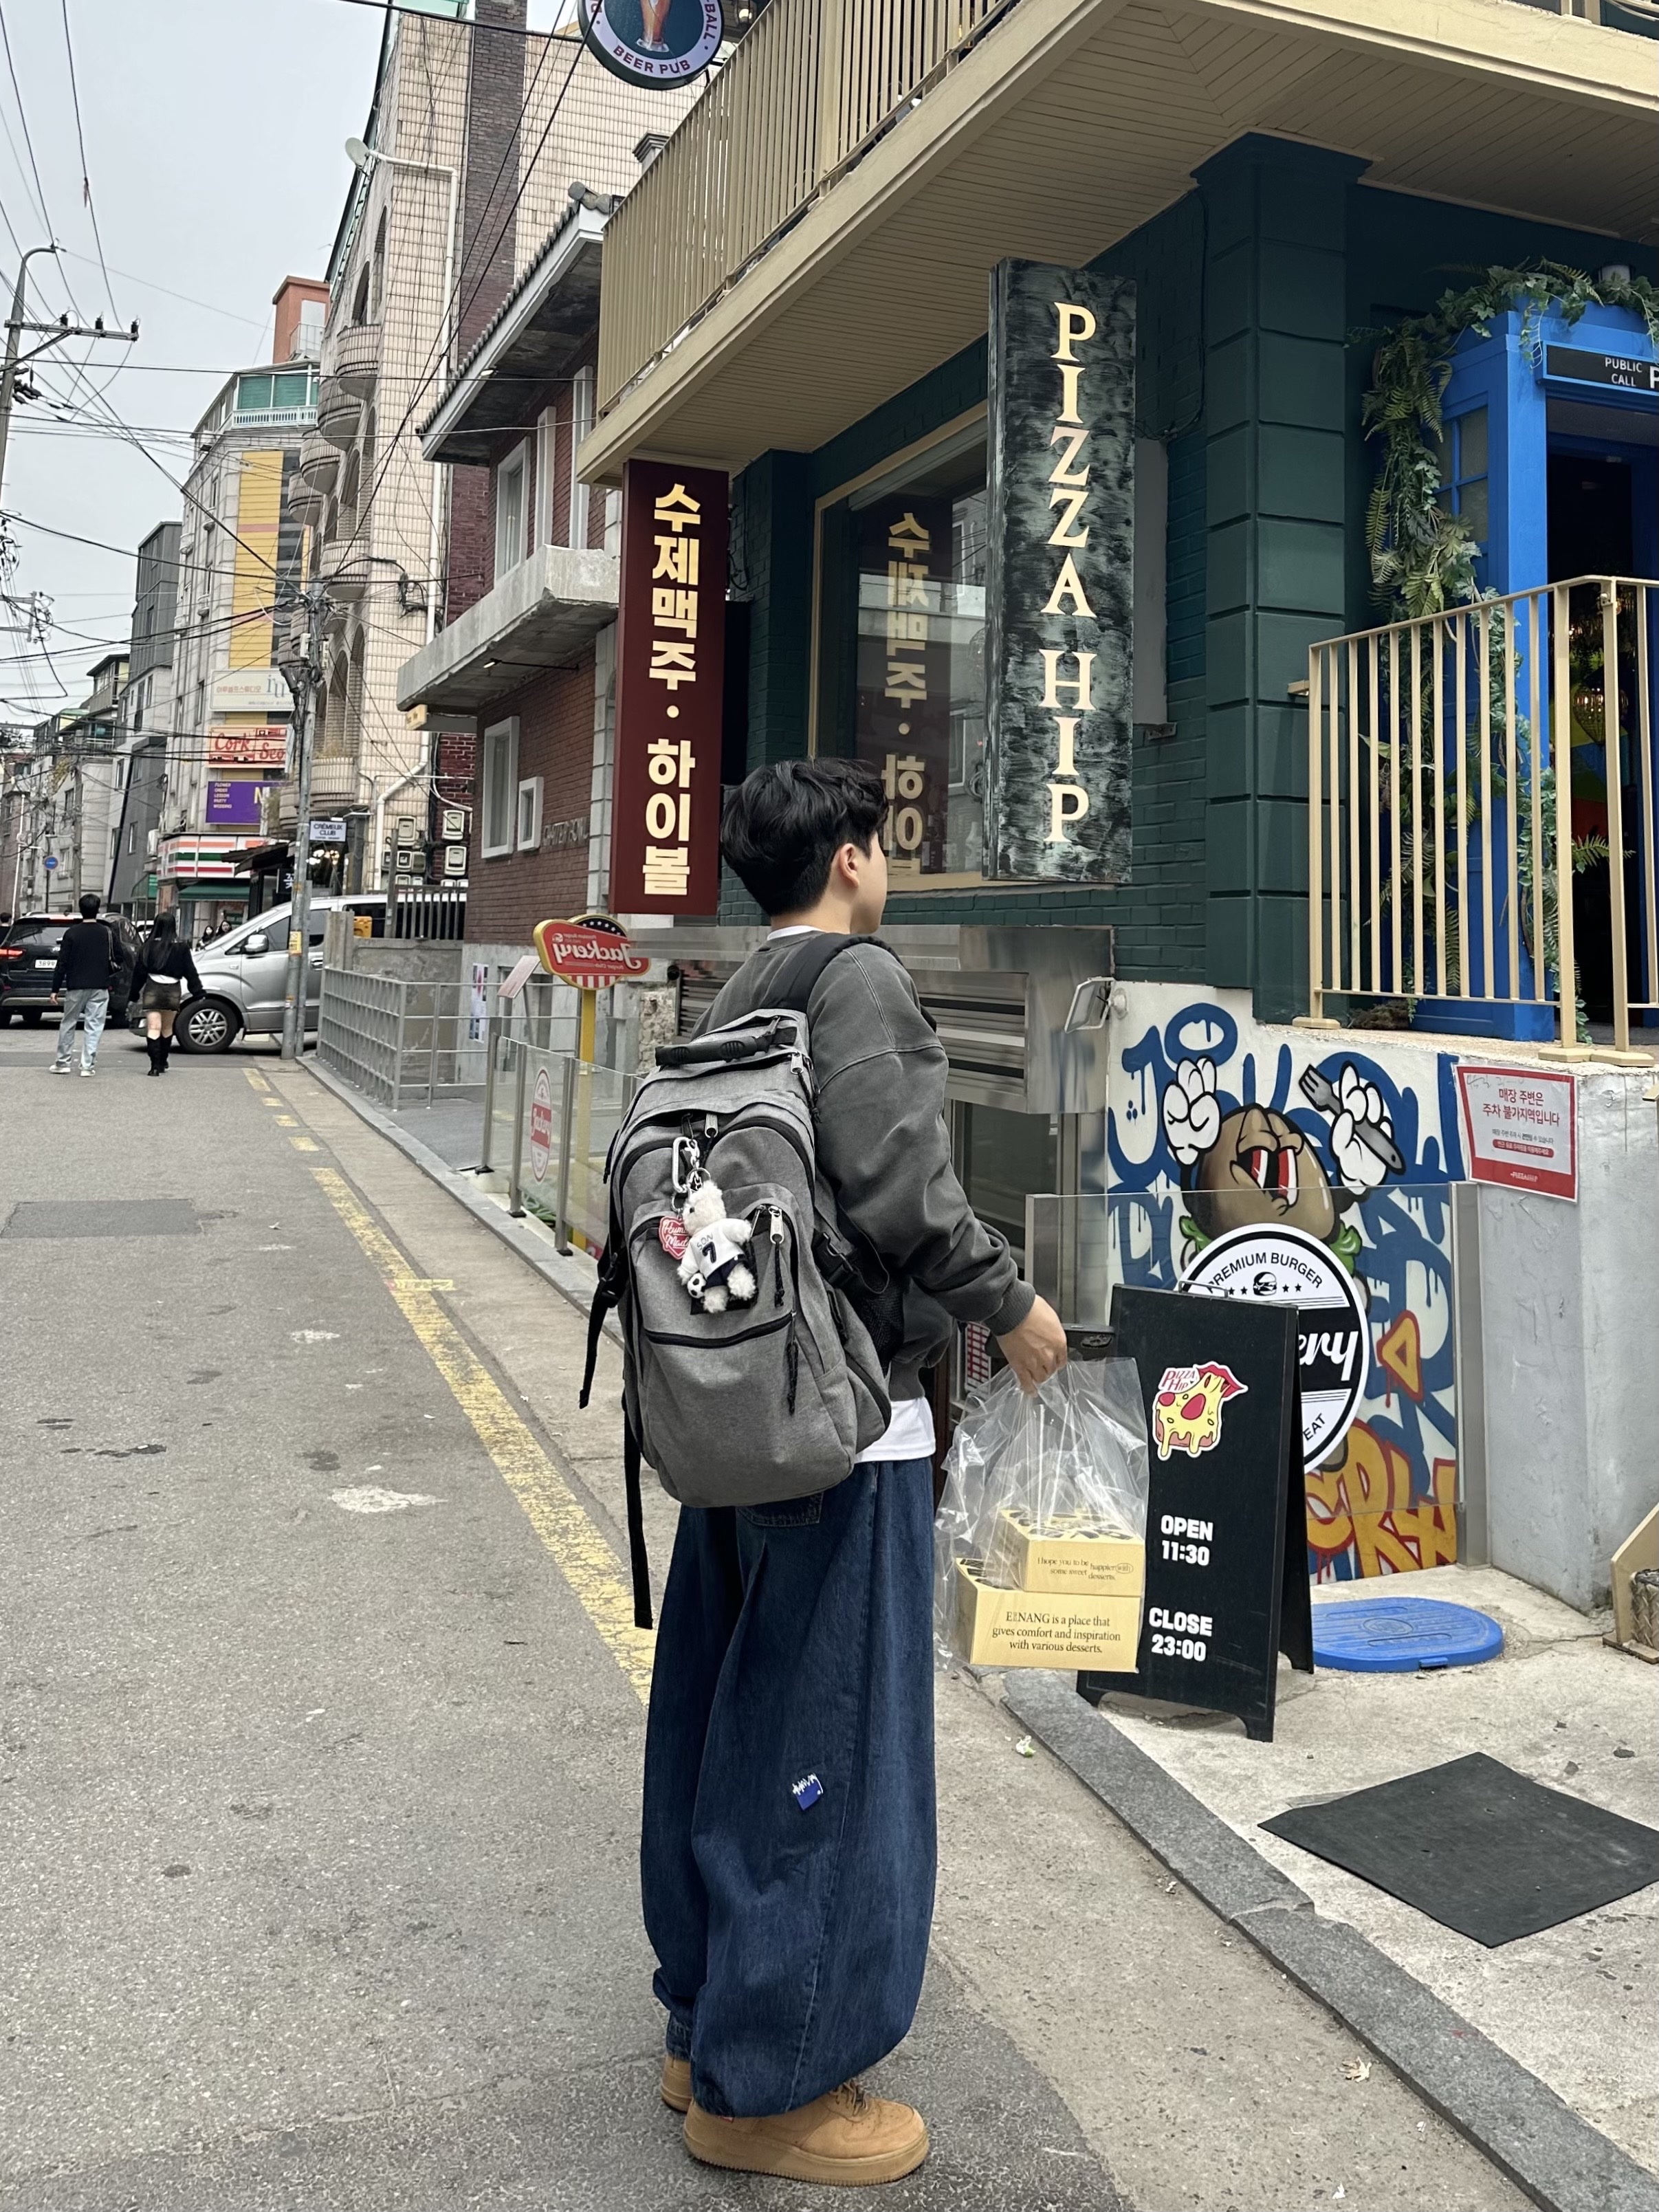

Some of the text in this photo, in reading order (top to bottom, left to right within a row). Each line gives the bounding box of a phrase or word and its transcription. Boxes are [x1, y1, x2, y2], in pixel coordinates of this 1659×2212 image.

[613, 45, 691, 74] BEER PUB
[1605, 356, 1642, 373] PUBLIC
[1611, 373, 1636, 387] CALL
[1038, 300, 1098, 843] PIZZA HIP
[215, 732, 250, 751] Cork
[1499, 1088, 1544, 1106] 매장 주변은
[1483, 1103, 1560, 1128] 주차 불가지역입니다
[663, 1219, 686, 1235] Hum
[665, 1234, 690, 1249] Mad
[696, 1233, 714, 1251] SON
[702, 1241, 716, 1264] 7
[1271, 1253, 1323, 1289] BURGER
[1161, 1370, 1196, 1388] PIZZA
[1303, 1412, 1326, 1441] EAT
[1161, 1515, 1213, 1541] OPEN
[1162, 1540, 1210, 1566] 11:30
[1041, 1557, 1057, 1567] hope
[1090, 1563, 1115, 1572] happier
[1052, 1614, 1059, 1624] is
[1068, 1614, 1091, 1628] place
[1093, 1616, 1110, 1627] that
[1149, 1607, 1213, 1636] CLOSE
[992, 1627, 1121, 1643] gives comfort and inspiration
[1009, 1639, 1103, 1653] with various desserts.
[1151, 1633, 1207, 1662] 23:00
